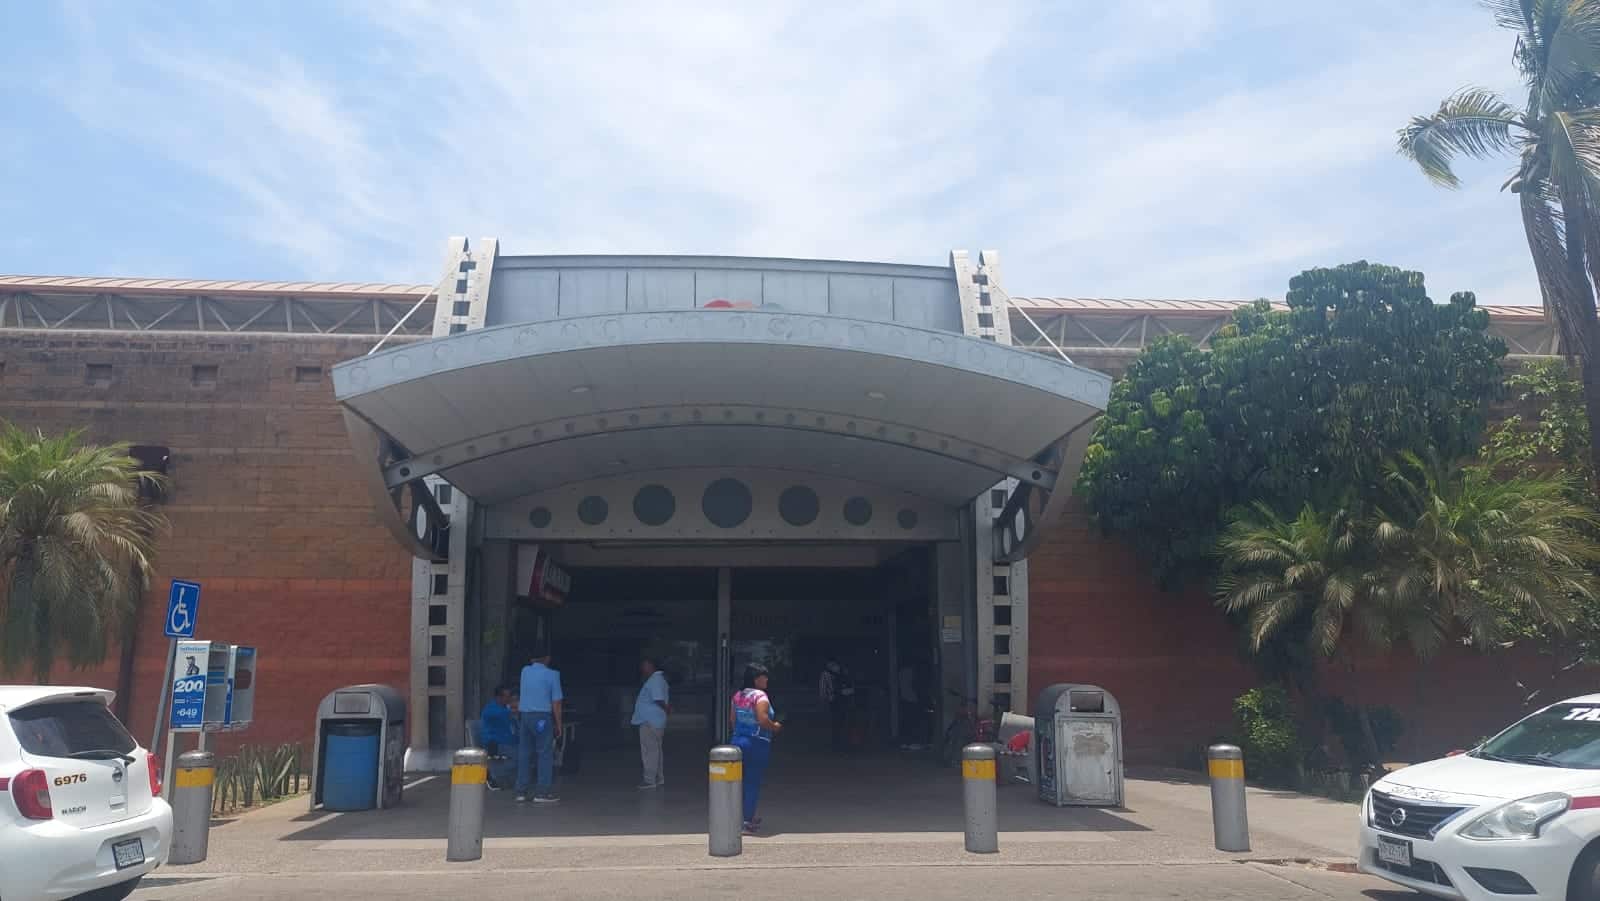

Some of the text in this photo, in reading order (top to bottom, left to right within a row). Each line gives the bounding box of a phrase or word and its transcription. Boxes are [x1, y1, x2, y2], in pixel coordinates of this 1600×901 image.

[174, 680, 204, 693] 200
[1562, 707, 1600, 721] TA
[54, 773, 87, 786] 6976
